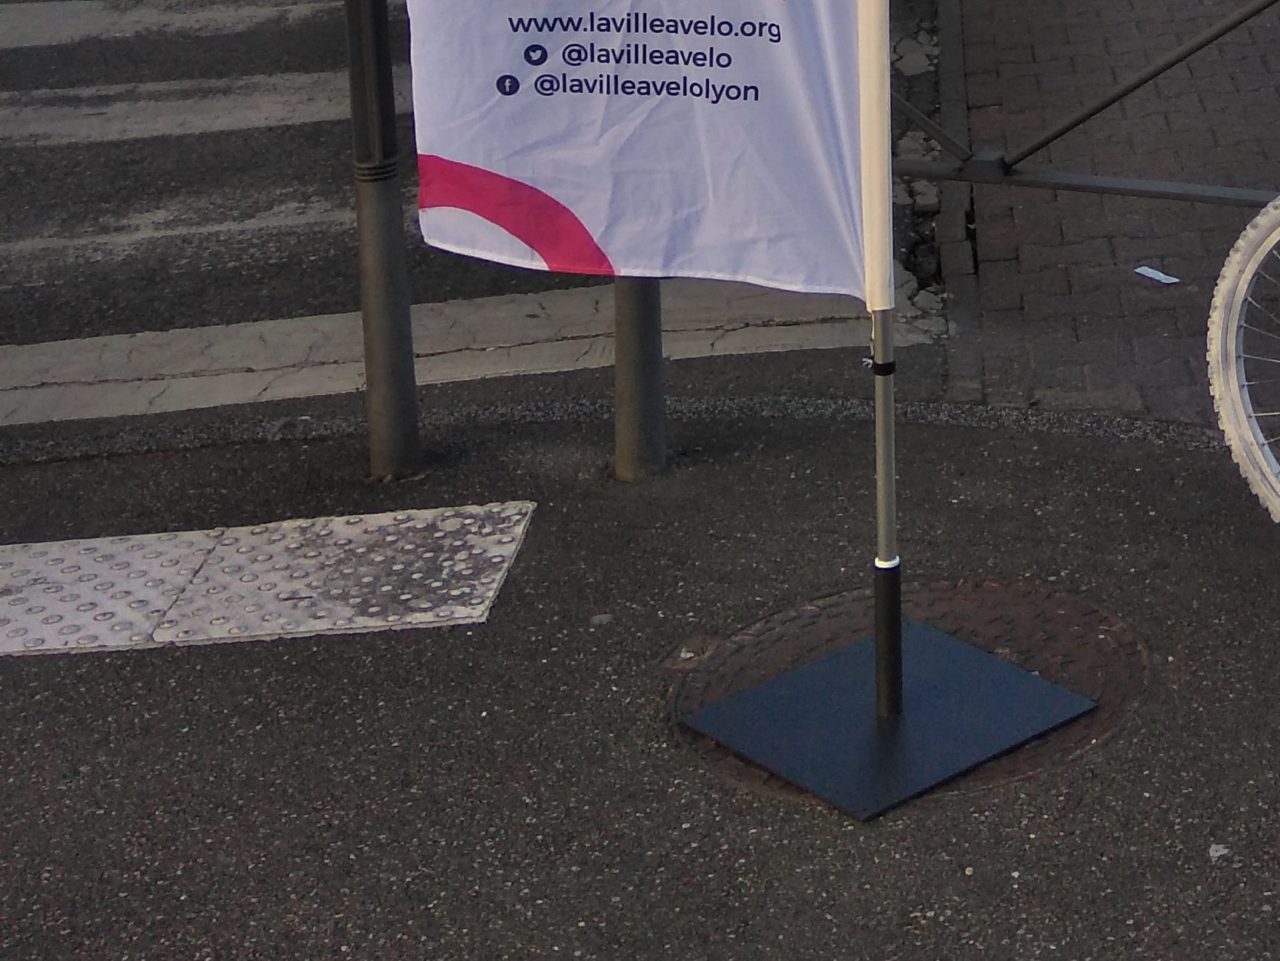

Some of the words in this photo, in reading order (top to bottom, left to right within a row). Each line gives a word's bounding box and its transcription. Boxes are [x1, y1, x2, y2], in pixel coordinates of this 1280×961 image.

[507, 11, 782, 44] www.lavilleavelo.org
[561, 42, 734, 69] @lavilleavelo
[533, 73, 760, 104] @lavilleavelolyon
